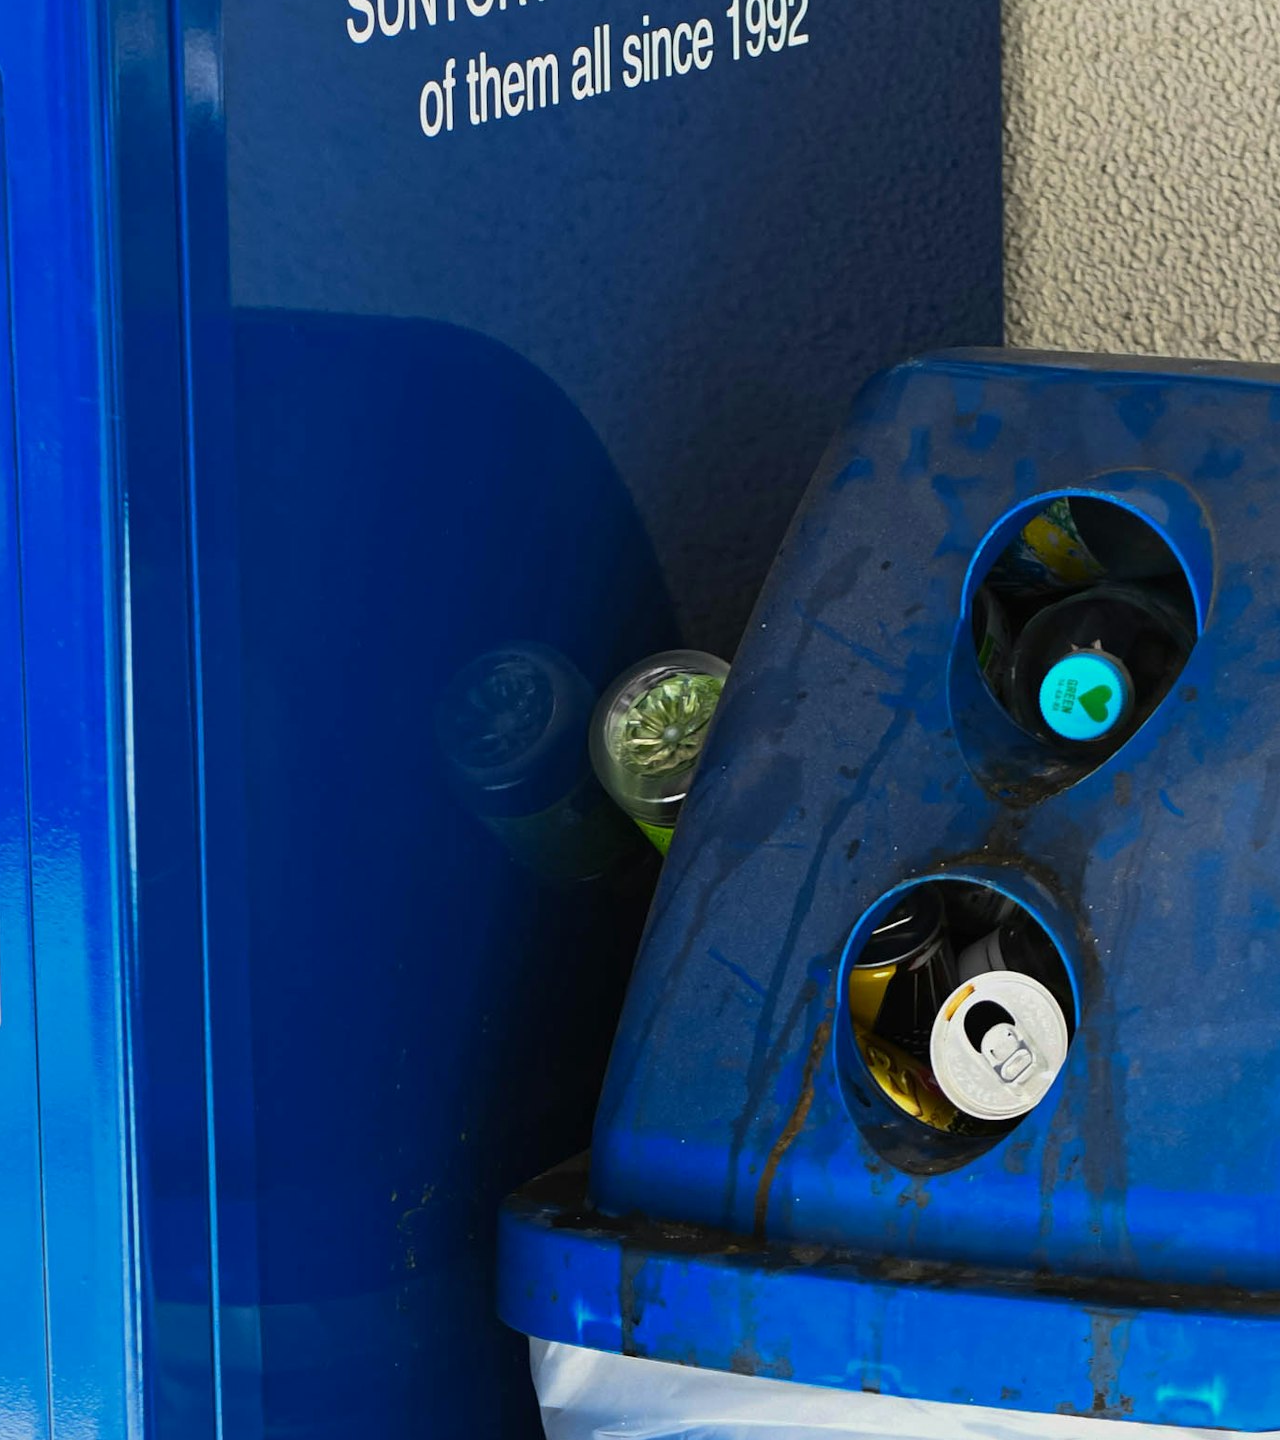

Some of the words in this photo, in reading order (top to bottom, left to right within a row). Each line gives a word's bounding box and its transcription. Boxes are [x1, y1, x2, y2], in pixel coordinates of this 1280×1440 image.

[420, 55, 456, 137] of
[467, 41, 559, 125] them
[571, 26, 611, 100] all
[622, 16, 714, 90] since
